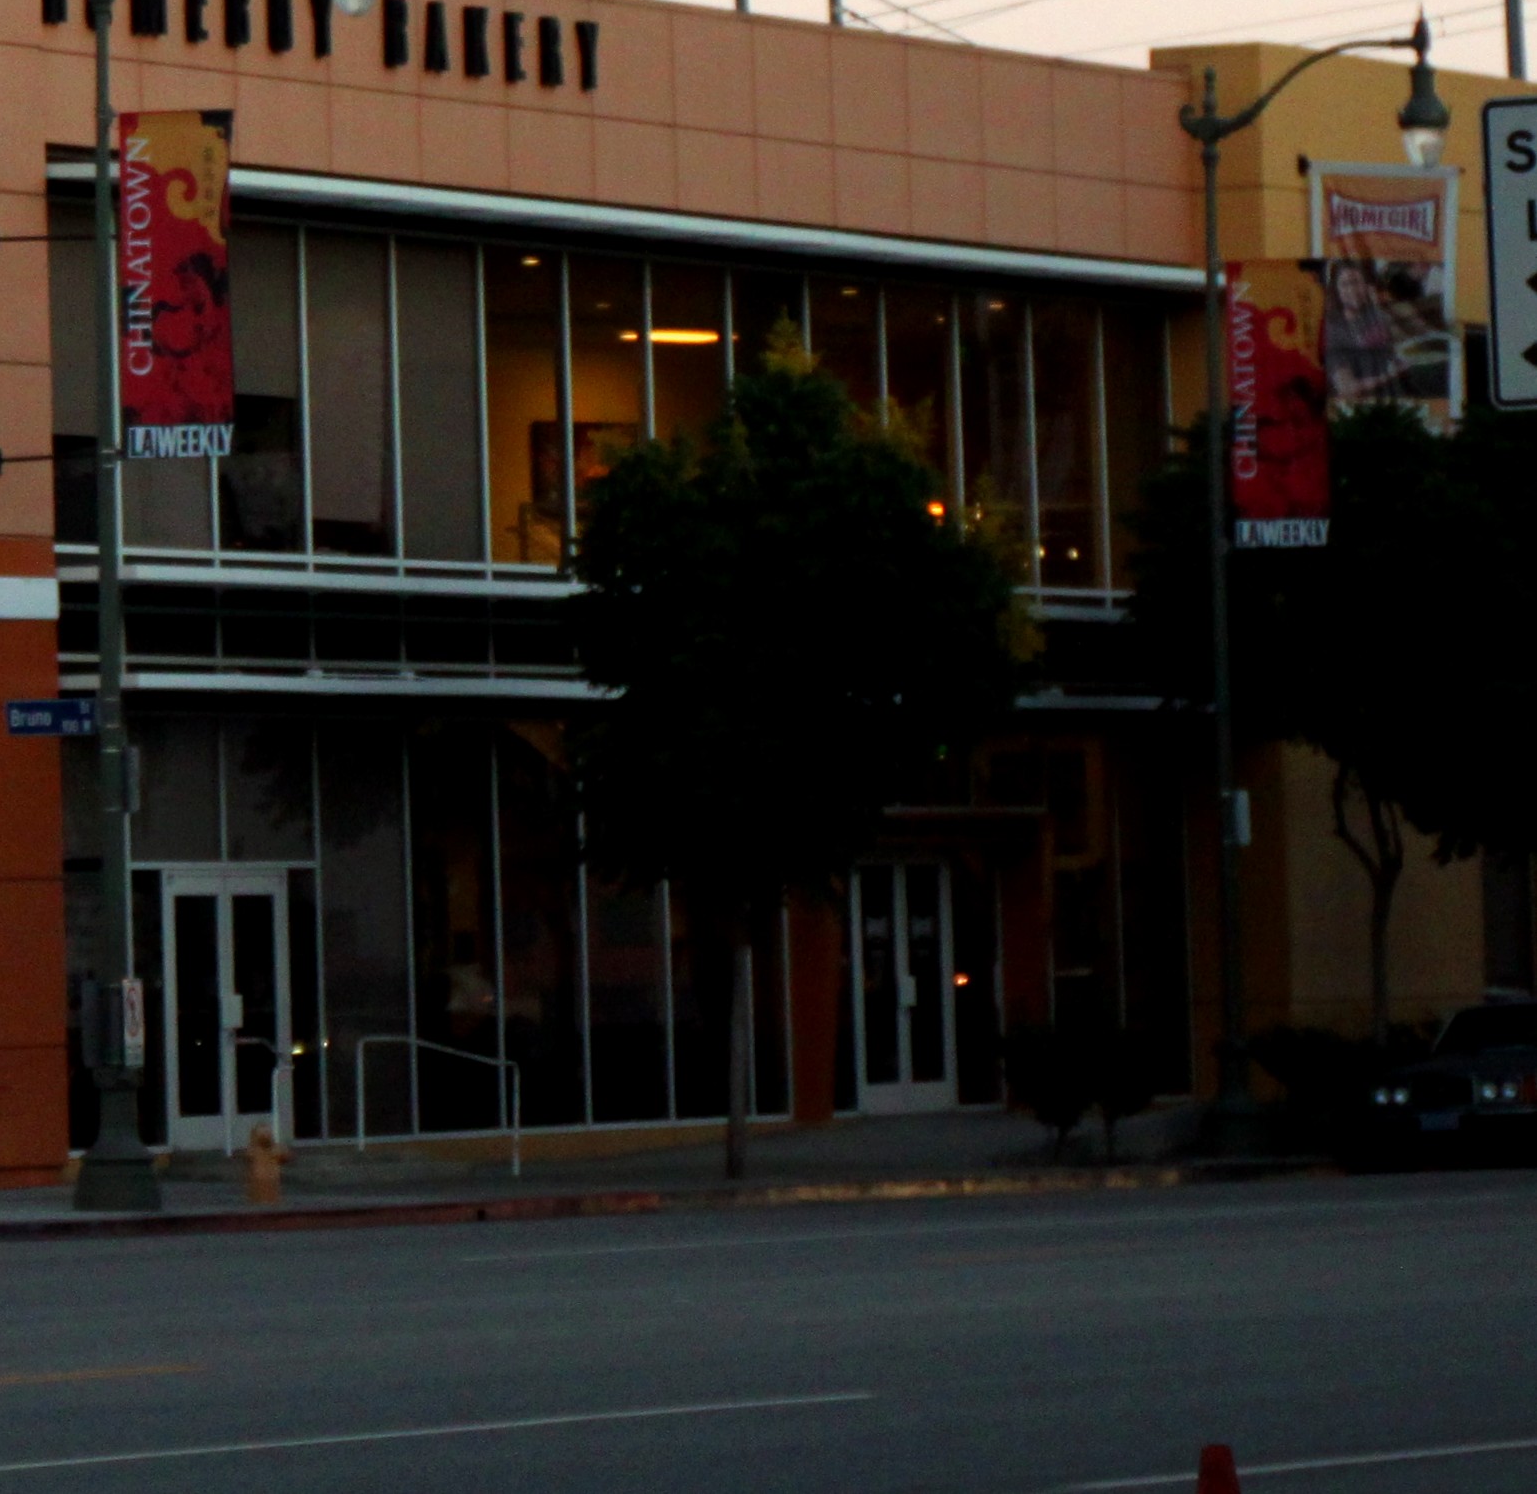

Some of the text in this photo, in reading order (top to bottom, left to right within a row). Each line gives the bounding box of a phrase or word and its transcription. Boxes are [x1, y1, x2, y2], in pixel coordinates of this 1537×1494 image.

[125, 136, 154, 377] CHINATOWN
[1231, 281, 1258, 481] CHINATOWN
[10, 708, 53, 728] Bruno
